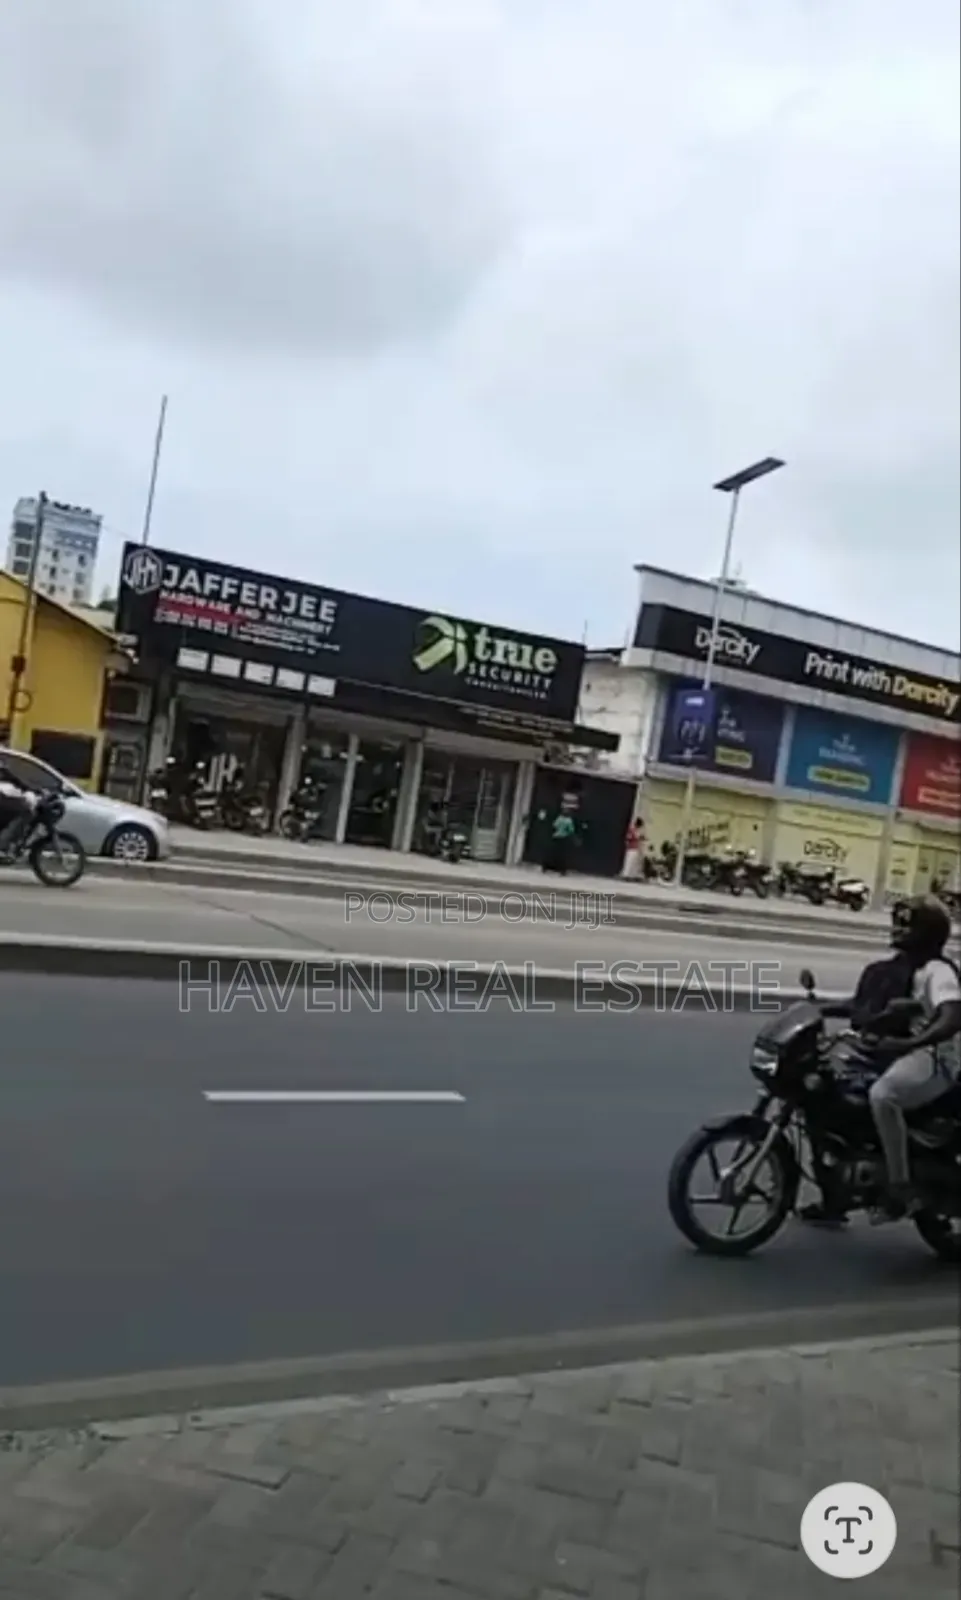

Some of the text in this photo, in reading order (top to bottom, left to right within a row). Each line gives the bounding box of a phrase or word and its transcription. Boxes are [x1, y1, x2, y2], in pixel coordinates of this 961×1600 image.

[159, 590, 333, 634] HARDWARE AND MACHINERY
[162, 563, 339, 623] JAFFERJEE
[473, 626, 558, 674] true
[468, 664, 553, 691] SECURITY
[804, 652, 960, 716] Print with Darcity
